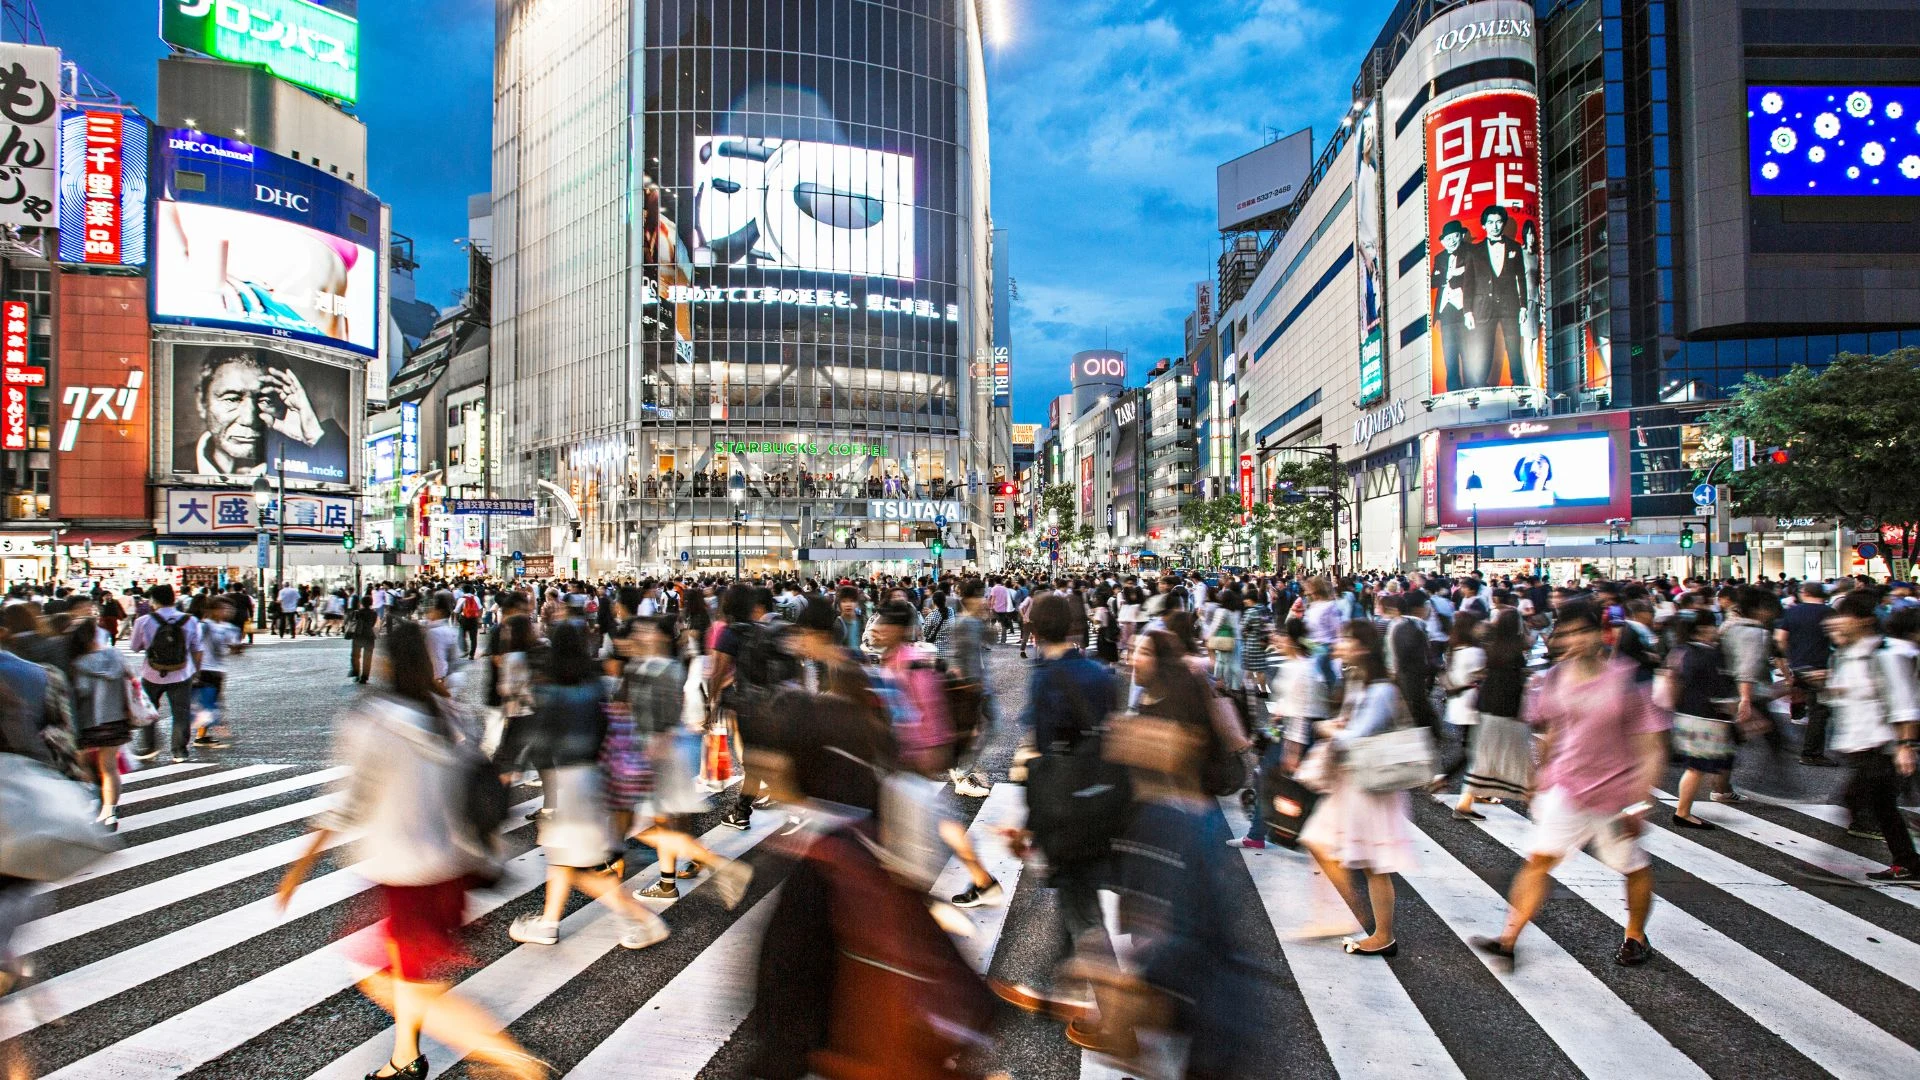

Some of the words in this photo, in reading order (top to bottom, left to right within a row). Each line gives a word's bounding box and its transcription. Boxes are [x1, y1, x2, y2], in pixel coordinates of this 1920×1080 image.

[0, 62, 57, 222] もんじゃ
[168, 138, 200, 153] DHC
[200, 142, 254, 163] Channel
[1436, 111, 1523, 172] 日本
[86, 117, 114, 254] 三千里薬品
[254, 184, 310, 212] DHC
[1437, 162, 1537, 217] ダービー
[1200, 285, 1211, 325] 大和証券
[272, 328, 292, 338] DHC
[994, 346, 1009, 396] SEIBU
[58, 370, 144, 452] クスリ
[1115, 400, 1136, 427] ZARA
[714, 441, 818, 455] STARBUCKS
[828, 442, 889, 457] COFFEE
[178, 498, 348, 529] 大盛堂書店
[872, 501, 959, 519] TSUTAYA
